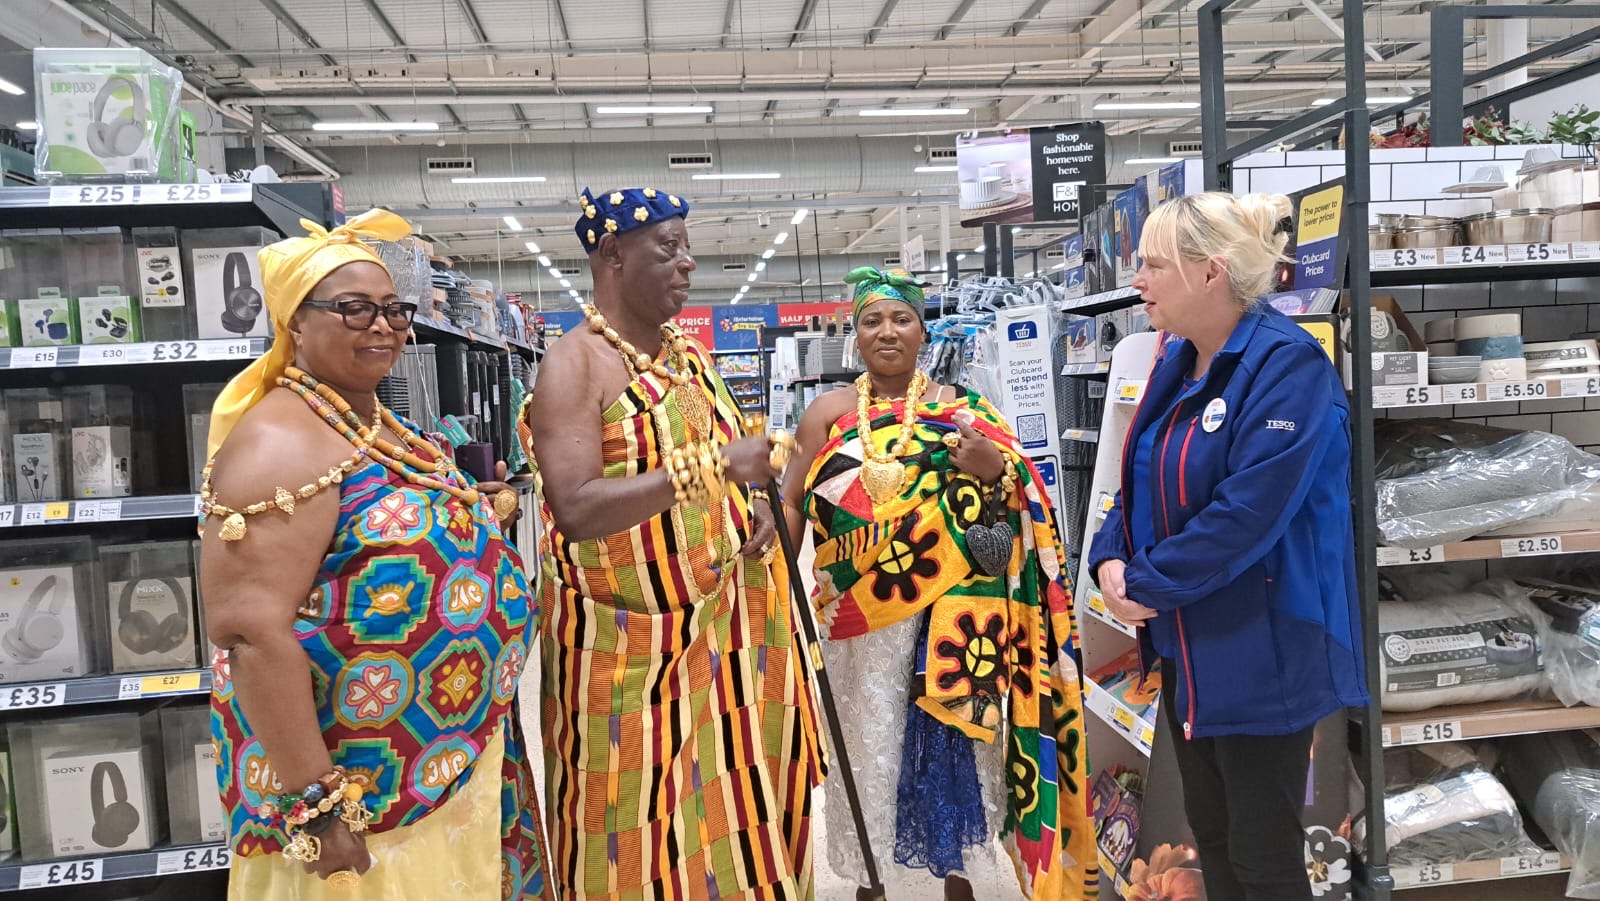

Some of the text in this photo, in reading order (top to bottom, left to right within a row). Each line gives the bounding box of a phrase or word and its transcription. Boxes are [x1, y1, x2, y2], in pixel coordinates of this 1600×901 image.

[1056, 133, 1080, 143] Shop
[1042, 142, 1094, 155] fashionable
[1046, 154, 1094, 166] homeware
[1057, 166, 1080, 175] here.
[79, 185, 125, 204] £25
[166, 184, 212, 202] £25
[1053, 201, 1079, 213] HOM
[1303, 207, 1314, 216] The
[1313, 202, 1332, 217] power
[1303, 211, 1336, 227] lower prices
[1301, 248, 1330, 265] Clubcard
[1420, 252, 1436, 261] New
[1461, 246, 1486, 263] £4
[1488, 249, 1504, 258] New
[1526, 243, 1550, 260] £5
[1552, 247, 1568, 255] New
[1393, 249, 1418, 267] £3
[1304, 265, 1324, 277] Prices
[679, 317, 711, 327] PRICE
[780, 315, 803, 324] HALF
[102, 349, 123, 358] £30
[152, 342, 198, 361] £32
[228, 344, 248, 355] £18
[34, 352, 55, 362] £15
[1027, 358, 1043, 366] your
[1010, 366, 1043, 375] Clubcard
[1006, 373, 1048, 385] and spend
[1011, 384, 1029, 392] less
[1460, 388, 1476, 399] £3
[1504, 382, 1545, 398] £5.50
[1013, 391, 1045, 401] Clubcard
[1405, 387, 1430, 404] £5
[1265, 419, 1296, 429] TESCO
[26, 512, 41, 521] £12
[78, 509, 95, 518] £22
[1517, 537, 1559, 553] £2.50
[162, 675, 180, 686] £27
[121, 682, 140, 692] £35
[8, 684, 57, 707] £35
[1422, 722, 1454, 741] £15
[51, 766, 85, 775] SONY
[183, 847, 230, 870] £45
[47, 860, 95, 885] £45
[1419, 864, 1442, 882] £5
